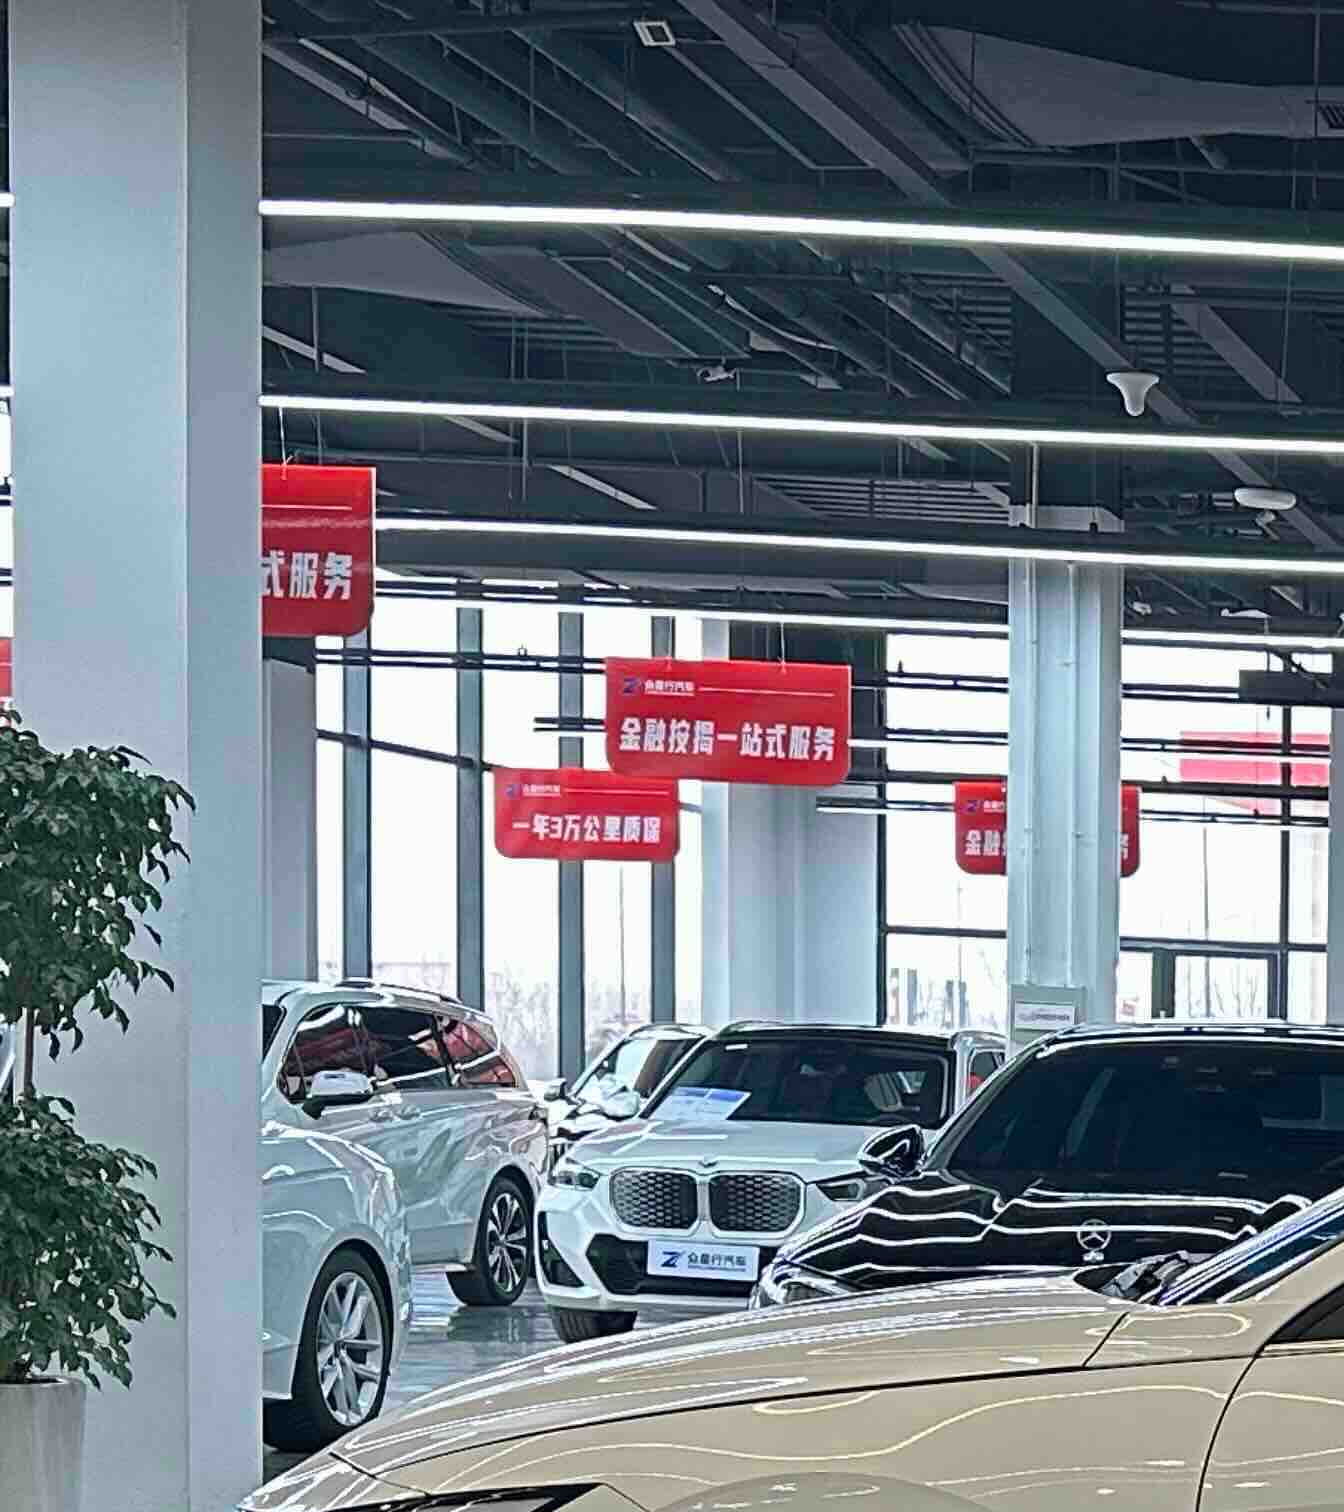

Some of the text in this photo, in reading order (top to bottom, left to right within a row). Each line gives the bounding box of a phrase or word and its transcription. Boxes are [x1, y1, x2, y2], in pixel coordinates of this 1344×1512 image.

[618, 716, 835, 761] 金融按揭一站式服务
[512, 813, 661, 844] 一年3万公里质保
